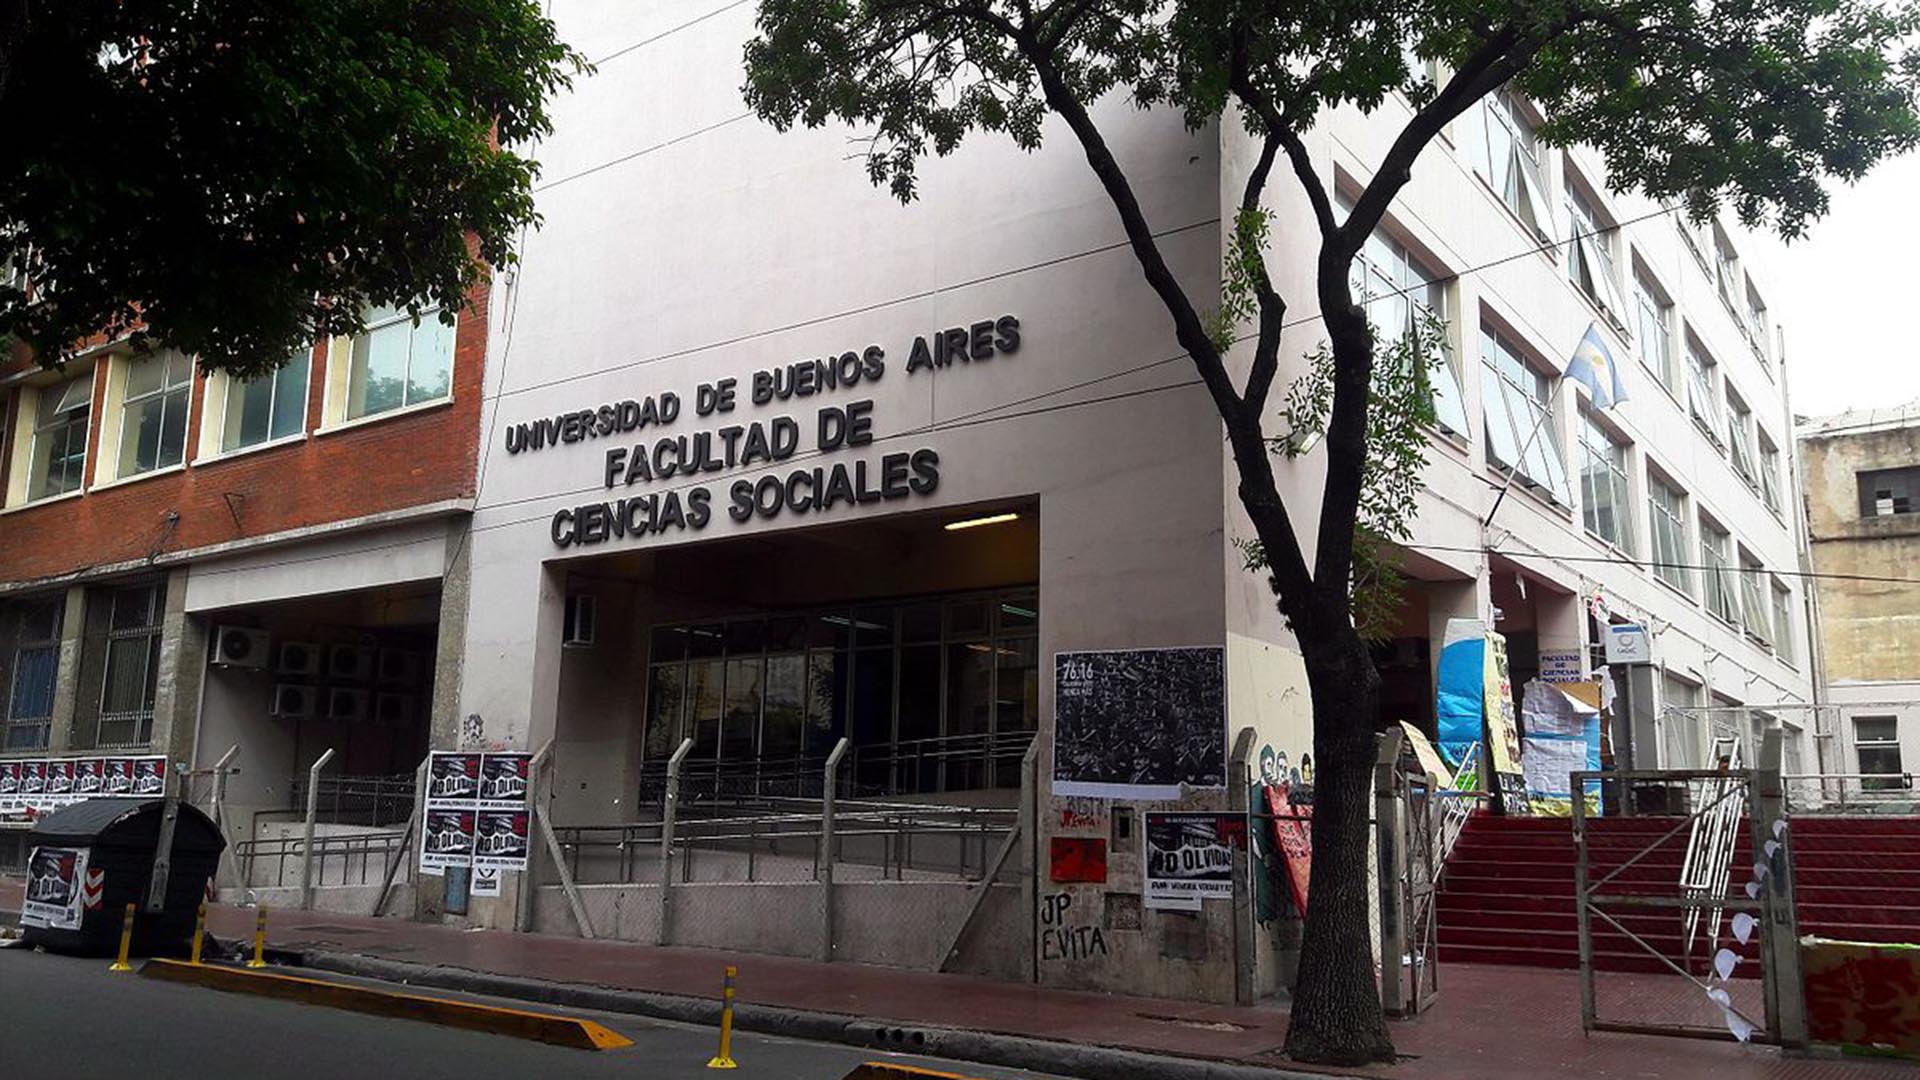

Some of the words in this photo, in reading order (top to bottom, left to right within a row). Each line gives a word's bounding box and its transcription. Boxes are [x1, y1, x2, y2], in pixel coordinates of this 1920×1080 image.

[505, 391, 681, 454] UNIVERSIDAD
[696, 377, 737, 416] DE
[752, 345, 885, 404] BUENOS
[906, 315, 1021, 374] AIRES
[605, 416, 799, 488] FACULTAD
[817, 400, 874, 450] DE
[551, 488, 711, 547] CIENCIAS
[729, 448, 939, 521] SOCIALES
[1151, 849, 1178, 872] NO
[1041, 893, 1071, 926] JP
